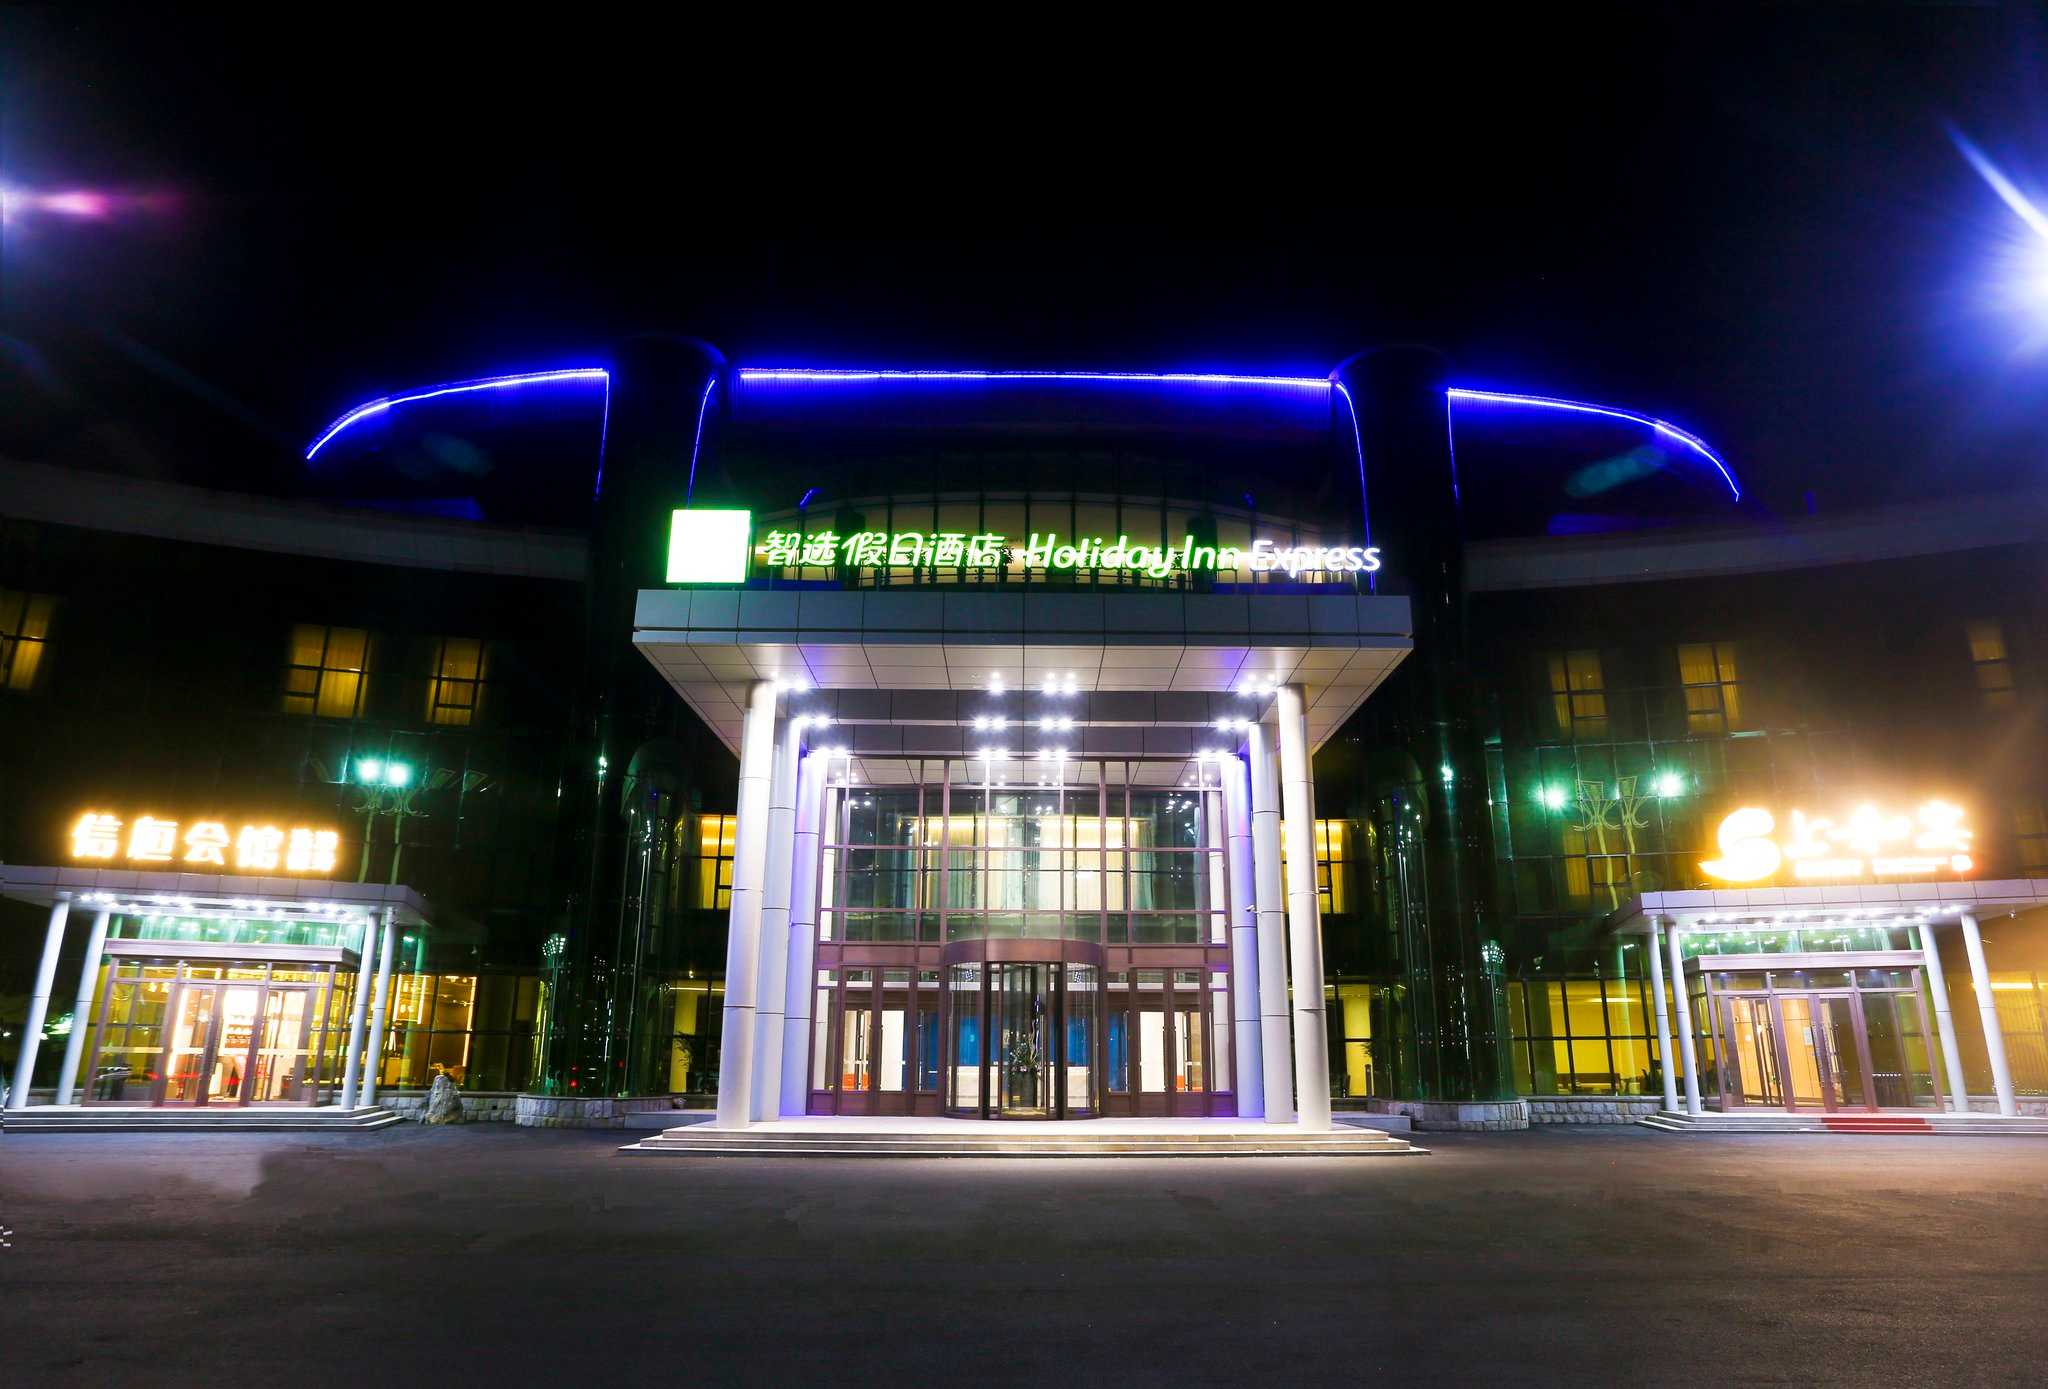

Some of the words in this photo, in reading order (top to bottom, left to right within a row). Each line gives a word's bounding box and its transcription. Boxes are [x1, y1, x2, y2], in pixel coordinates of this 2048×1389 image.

[764, 530, 1006, 568] 智选假日酒店
[1024, 532, 1177, 578] Holiday
[1182, 534, 1241, 570] Inn
[1250, 539, 1381, 578] Express
